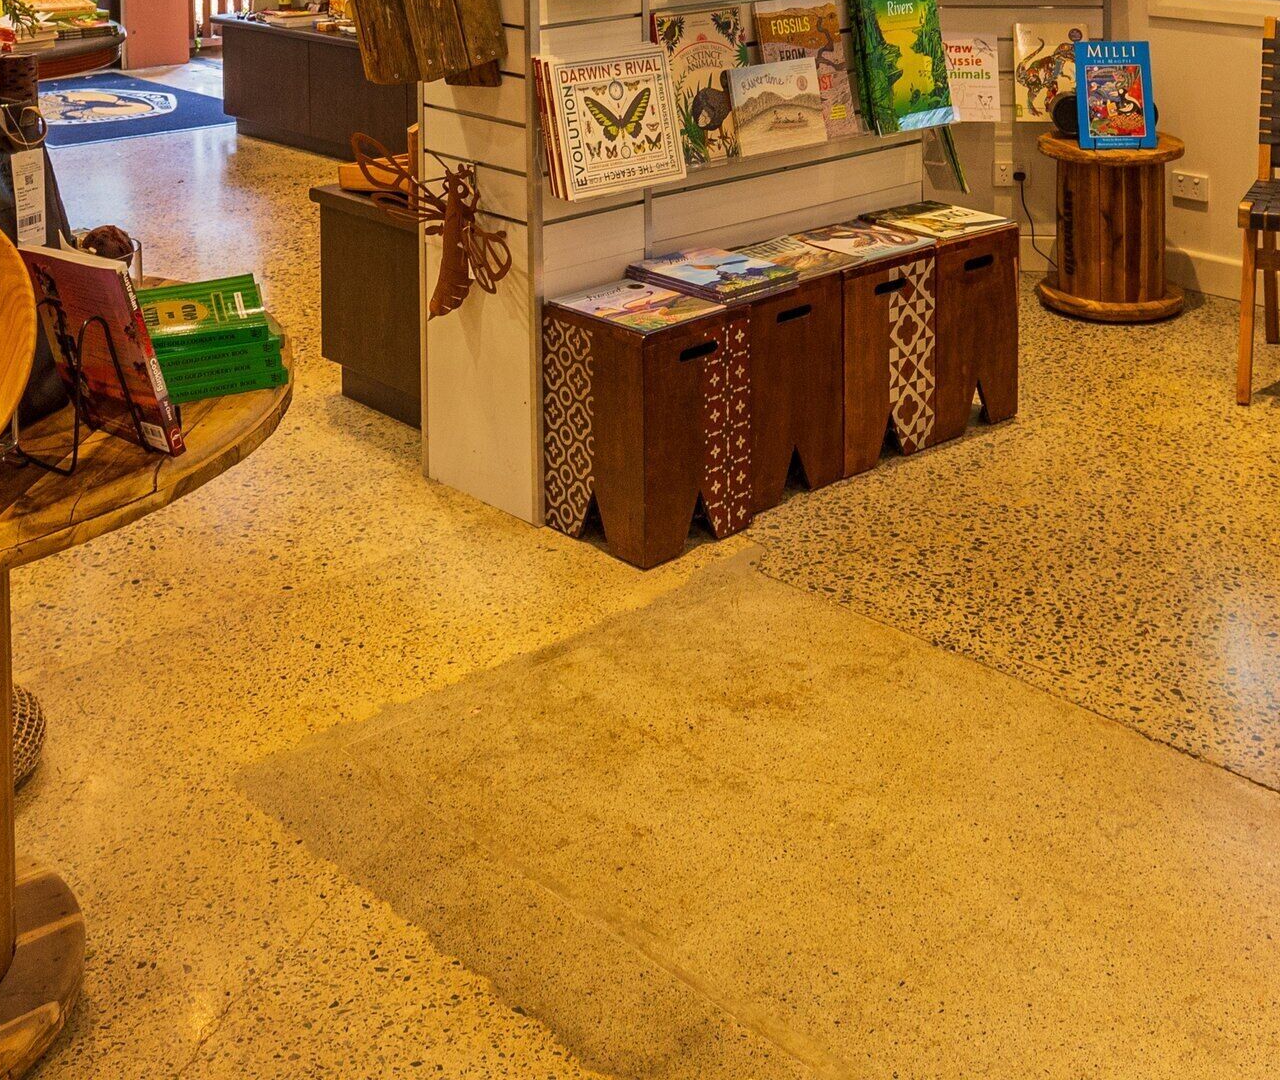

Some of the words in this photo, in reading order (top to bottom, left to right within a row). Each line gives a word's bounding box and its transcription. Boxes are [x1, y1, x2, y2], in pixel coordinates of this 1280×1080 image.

[887, 0, 914, 17] Rivers
[770, 16, 811, 35] FOSSILS
[686, 50, 722, 65] EXTINCT
[779, 48, 807, 61] FROM
[1087, 44, 1136, 58] MILLI
[687, 59, 723, 74] ANIMALS
[948, 56, 982, 66] ussie
[560, 63, 622, 84] DARWIN'S
[625, 58, 660, 75] RIVAL
[949, 70, 991, 80] nimals
[656, 73, 666, 102] ALFRED
[666, 134, 677, 168] WALLACE
[562, 85, 588, 187] EVOLUTION
[603, 166, 636, 180] SEARCH
[639, 163, 654, 176] THE
[181, 303, 198, 321] GOLD
[166, 338, 186, 347] GOLD
[186, 335, 217, 345] COOKERY
[219, 333, 236, 341] BOOK
[166, 360, 180, 368] AND
[181, 357, 200, 366] GOLD
[200, 353, 230, 363] COOKERY
[231, 349, 248, 357] BOOK
[149, 357, 164, 392] Cooking
[184, 372, 202, 380] GOLD
[203, 368, 233, 377] COOKERY
[235, 364, 251, 372] BOOK
[190, 388, 209, 396] GOLD
[209, 383, 238, 393] COOKERY
[240, 379, 256, 387] BOOK
